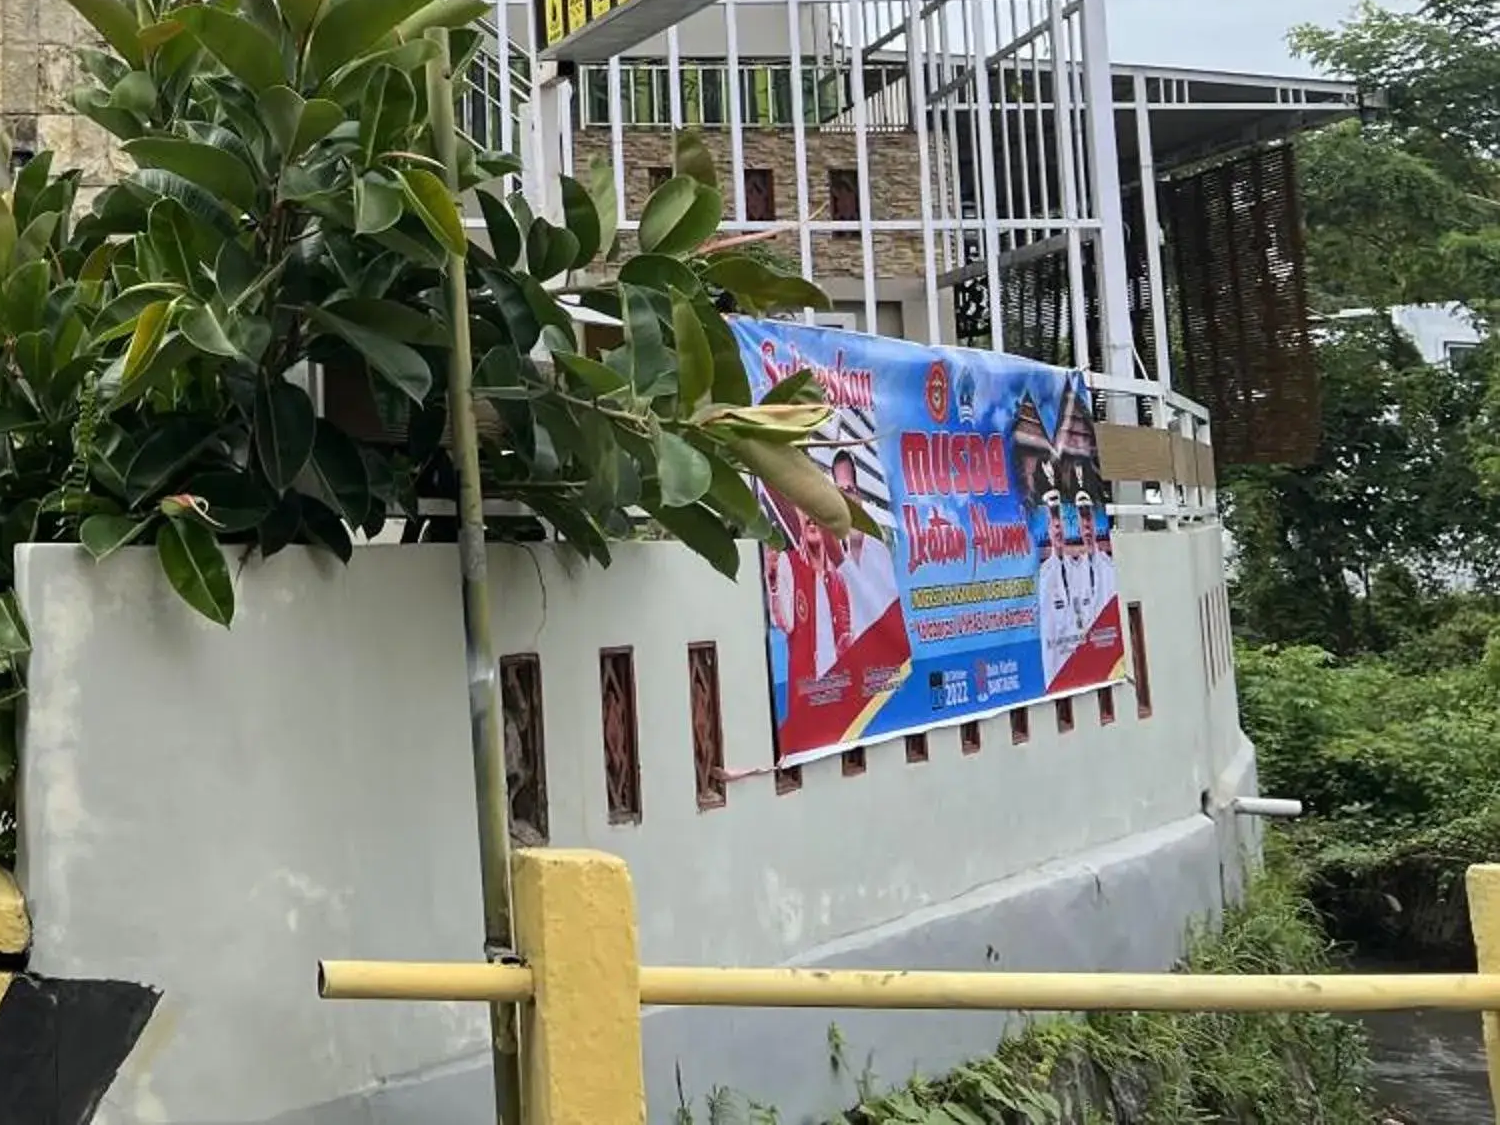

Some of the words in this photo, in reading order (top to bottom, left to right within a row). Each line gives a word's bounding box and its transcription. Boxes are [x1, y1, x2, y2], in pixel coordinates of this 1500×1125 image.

[900, 430, 1009, 496] MUSDA
[902, 503, 967, 574] Ikatan
[967, 502, 1032, 563] Alumni
[945, 679, 969, 707] 2022
